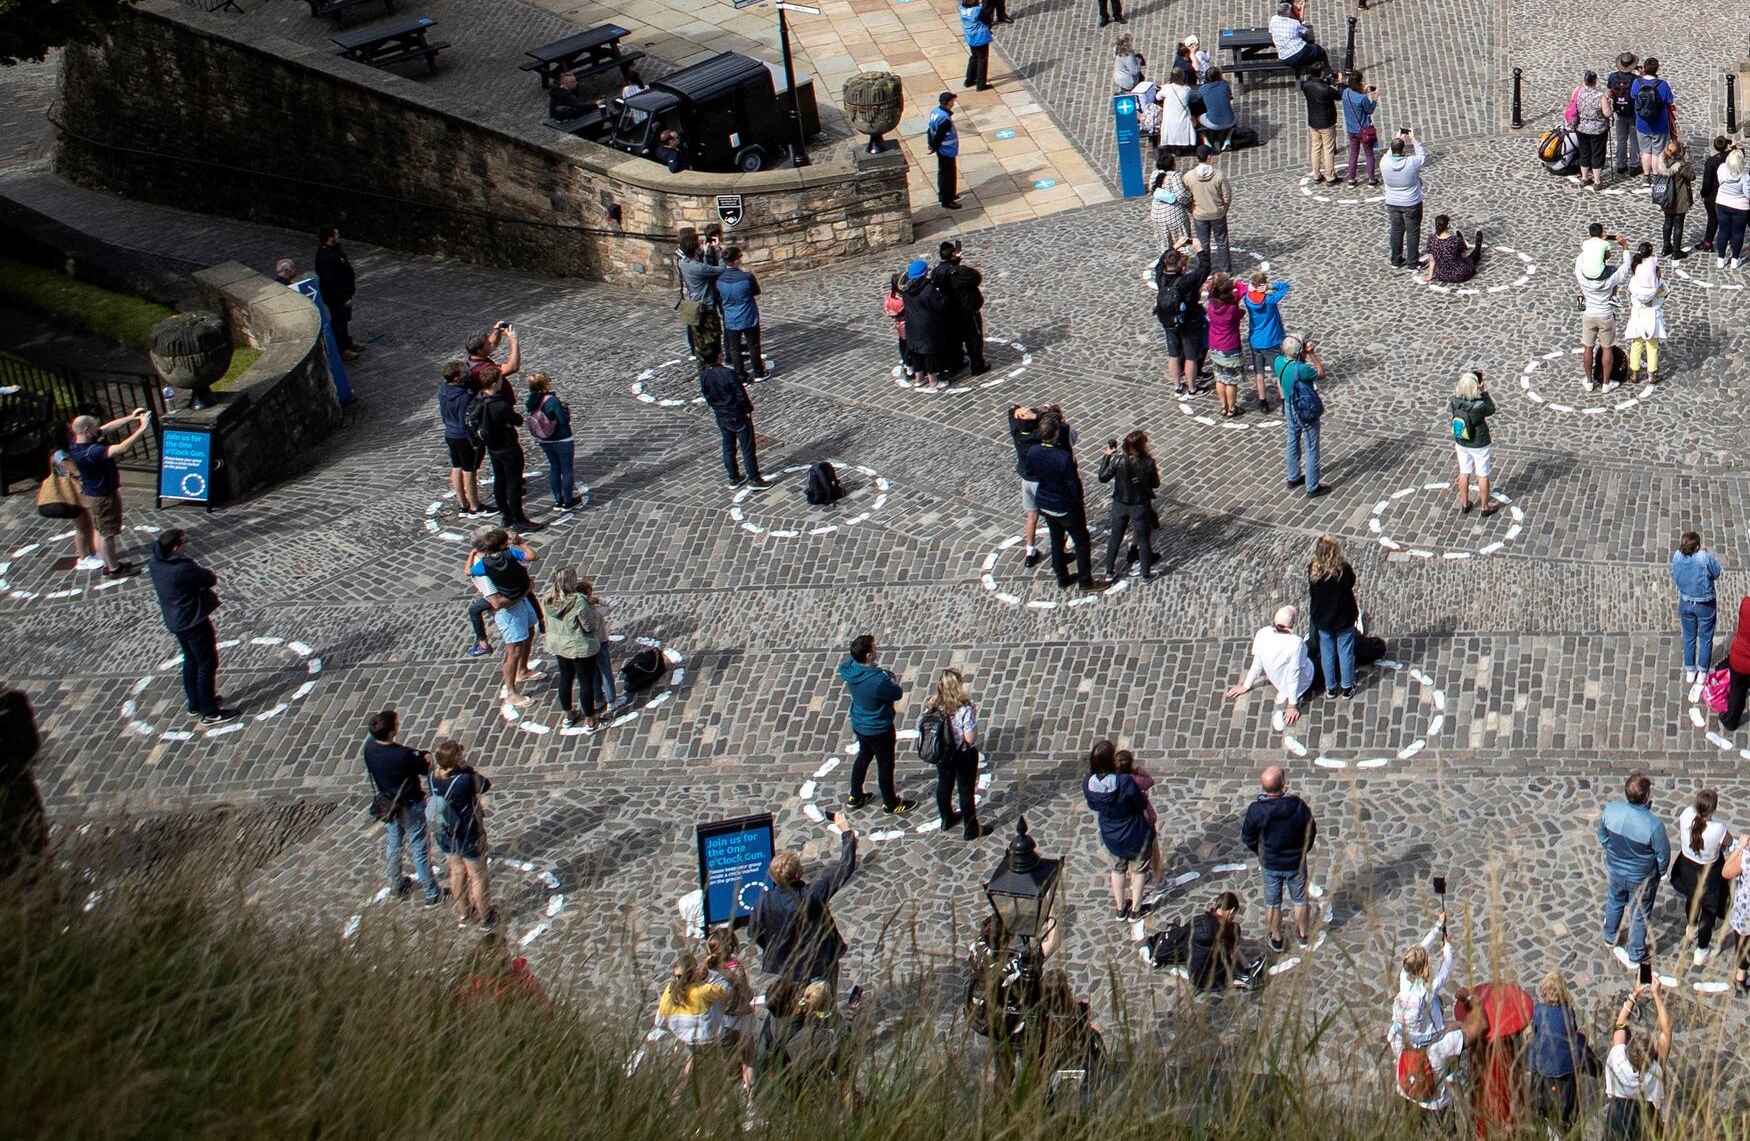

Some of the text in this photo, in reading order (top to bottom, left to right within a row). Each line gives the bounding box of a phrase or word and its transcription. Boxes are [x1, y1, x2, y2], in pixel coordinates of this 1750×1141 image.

[707, 834, 758, 848] Join us for
[708, 845, 746, 857] the One
[708, 851, 765, 867] o'Clock Gun.
